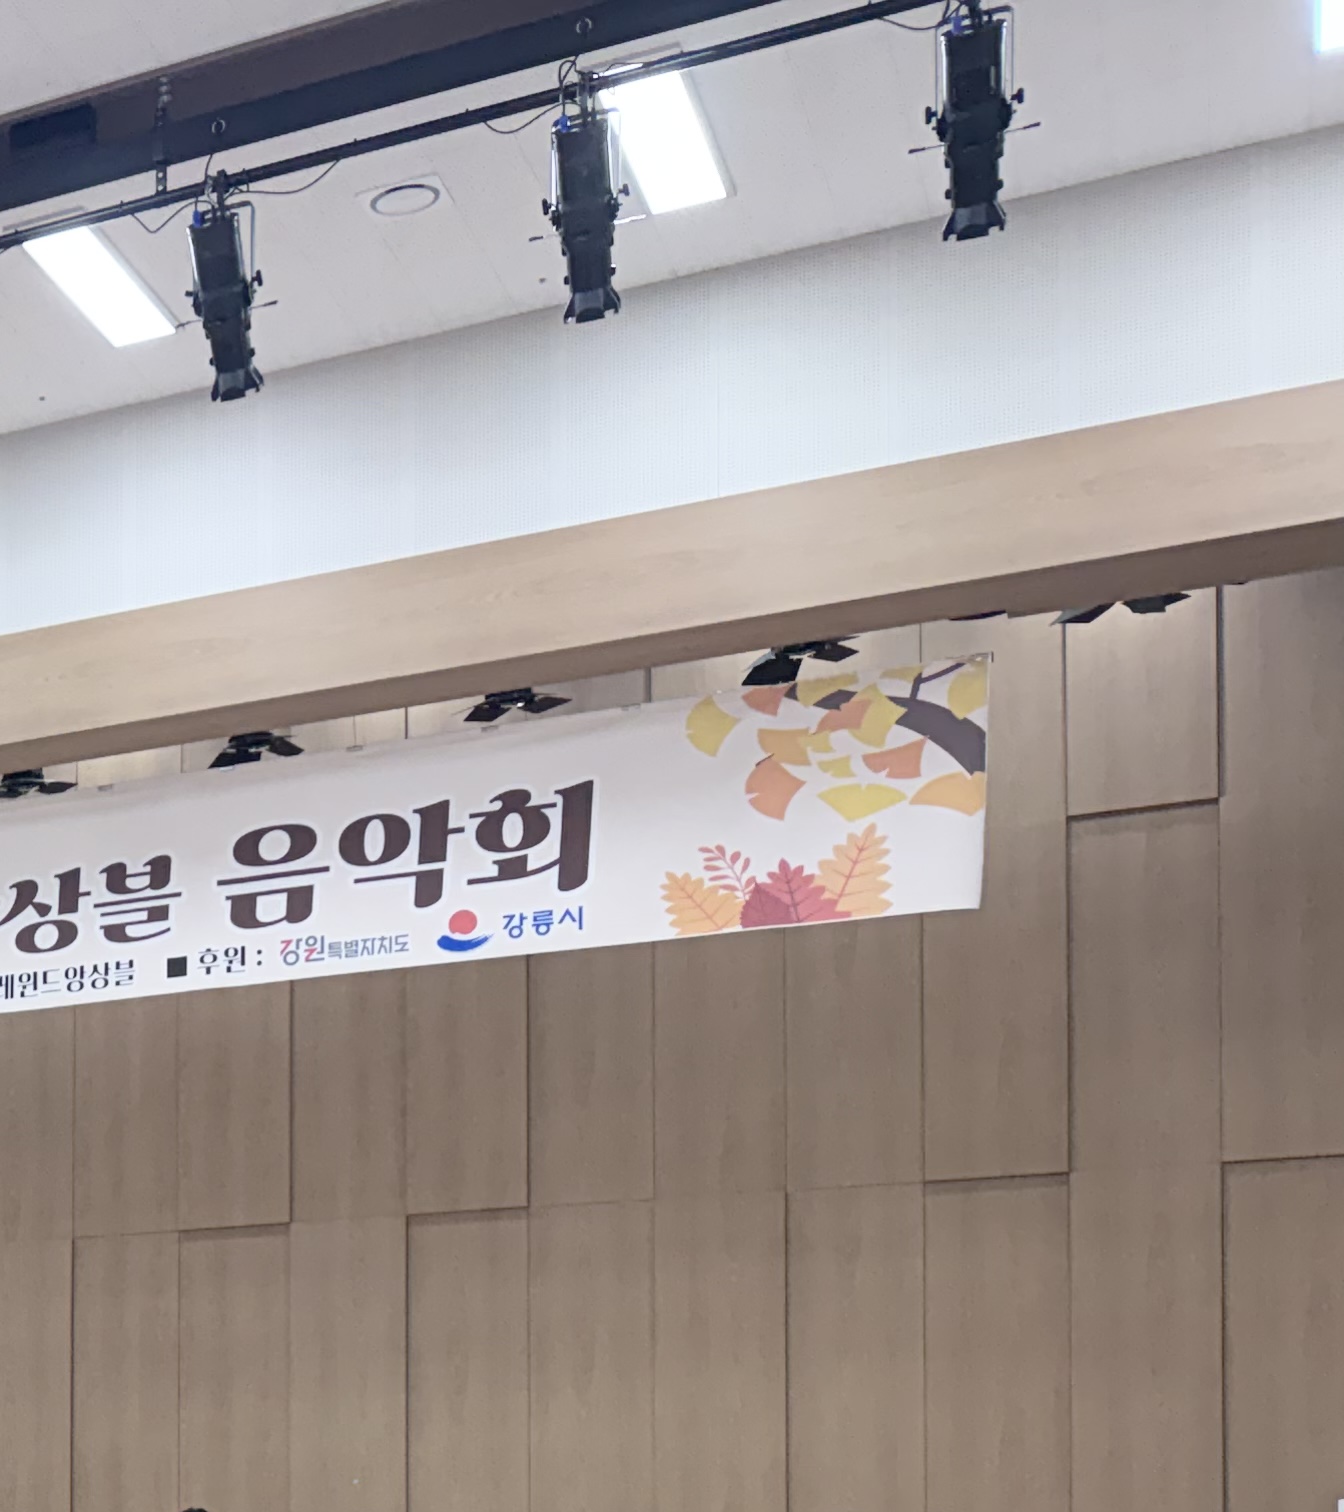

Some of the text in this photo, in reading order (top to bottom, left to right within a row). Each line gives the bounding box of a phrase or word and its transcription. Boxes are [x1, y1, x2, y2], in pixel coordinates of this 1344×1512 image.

[217, 779, 595, 930] 음악회
[197, 945, 247, 975] 후원
[502, 905, 585, 939] 강릉시
